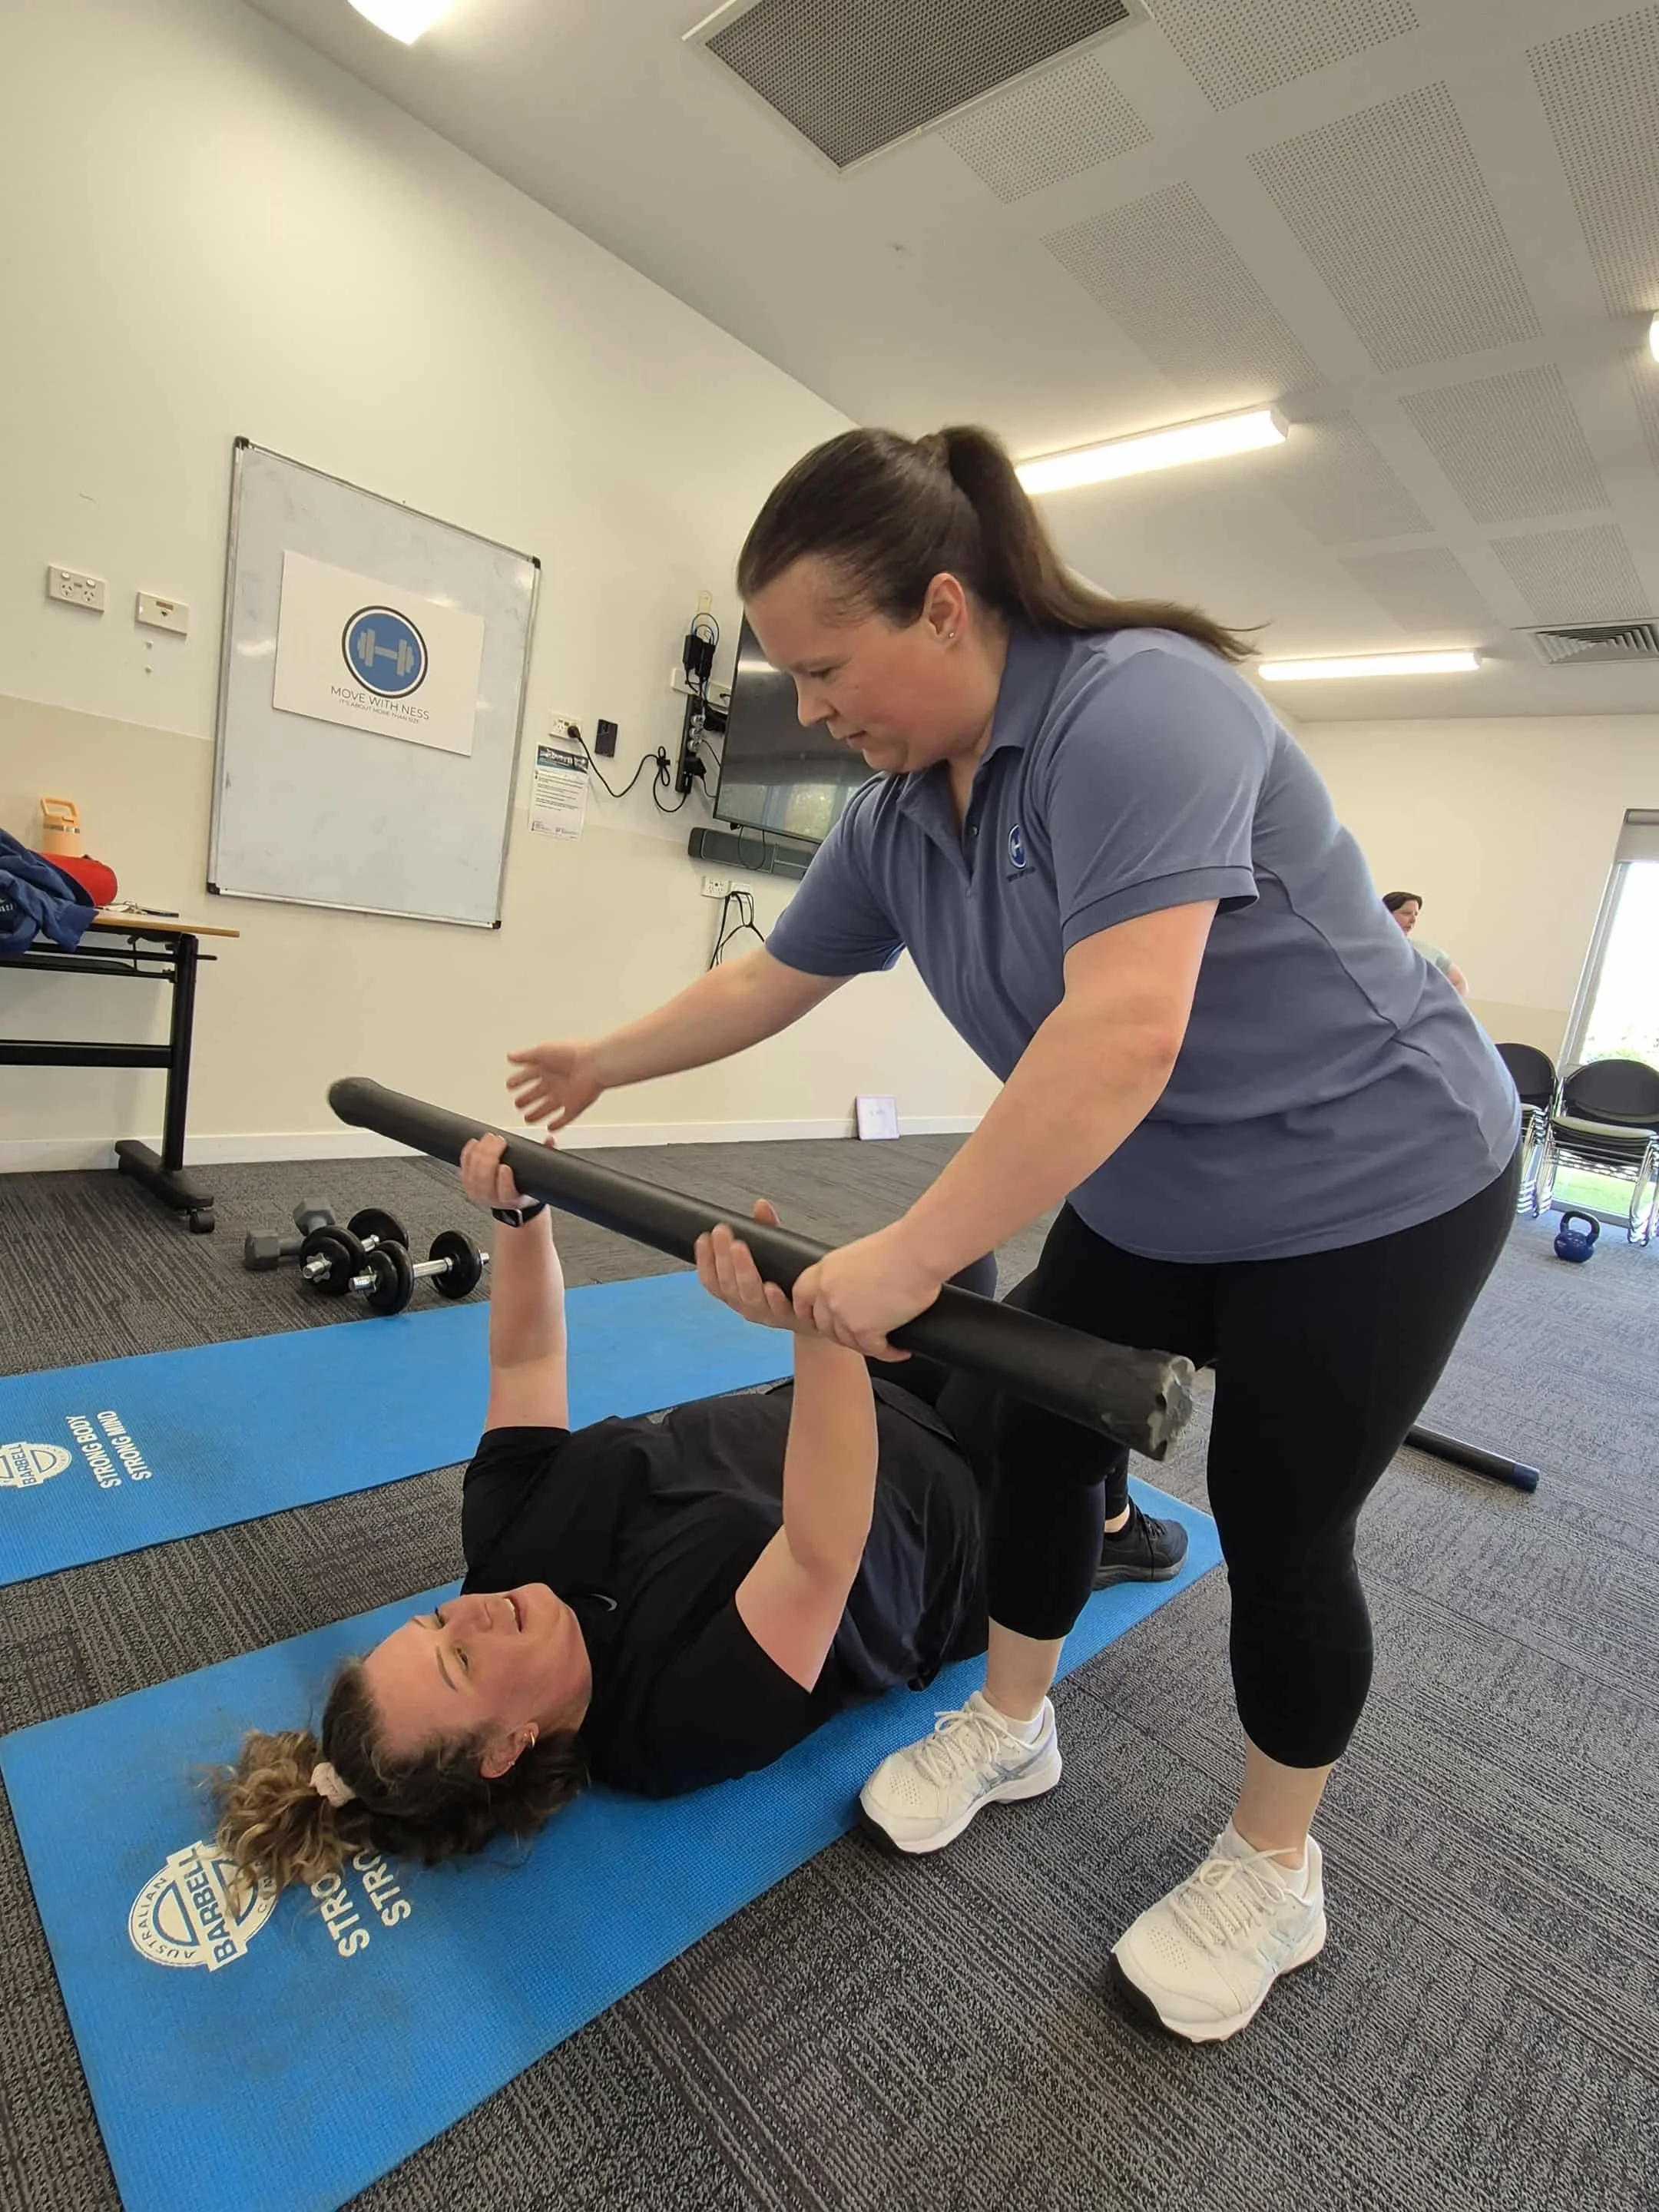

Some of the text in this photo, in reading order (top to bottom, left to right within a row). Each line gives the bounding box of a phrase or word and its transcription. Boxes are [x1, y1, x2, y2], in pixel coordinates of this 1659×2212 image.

[331, 686, 430, 720] MOVE WITH NESS
[350, 702, 372, 711] ABOUT
[373, 707, 390, 716] MORE
[392, 712, 407, 720] THAN
[8, 1444, 38, 1485] BARBELL
[65, 1416, 123, 1489] STRONG BODY
[97, 1410, 153, 1481] STRONG MIND
[137, 1877, 197, 1959] AUSTRALIAN
[178, 1847, 237, 1964] BARBELL
[310, 1872, 370, 1958] STRO
[353, 1849, 412, 1927] STRO
